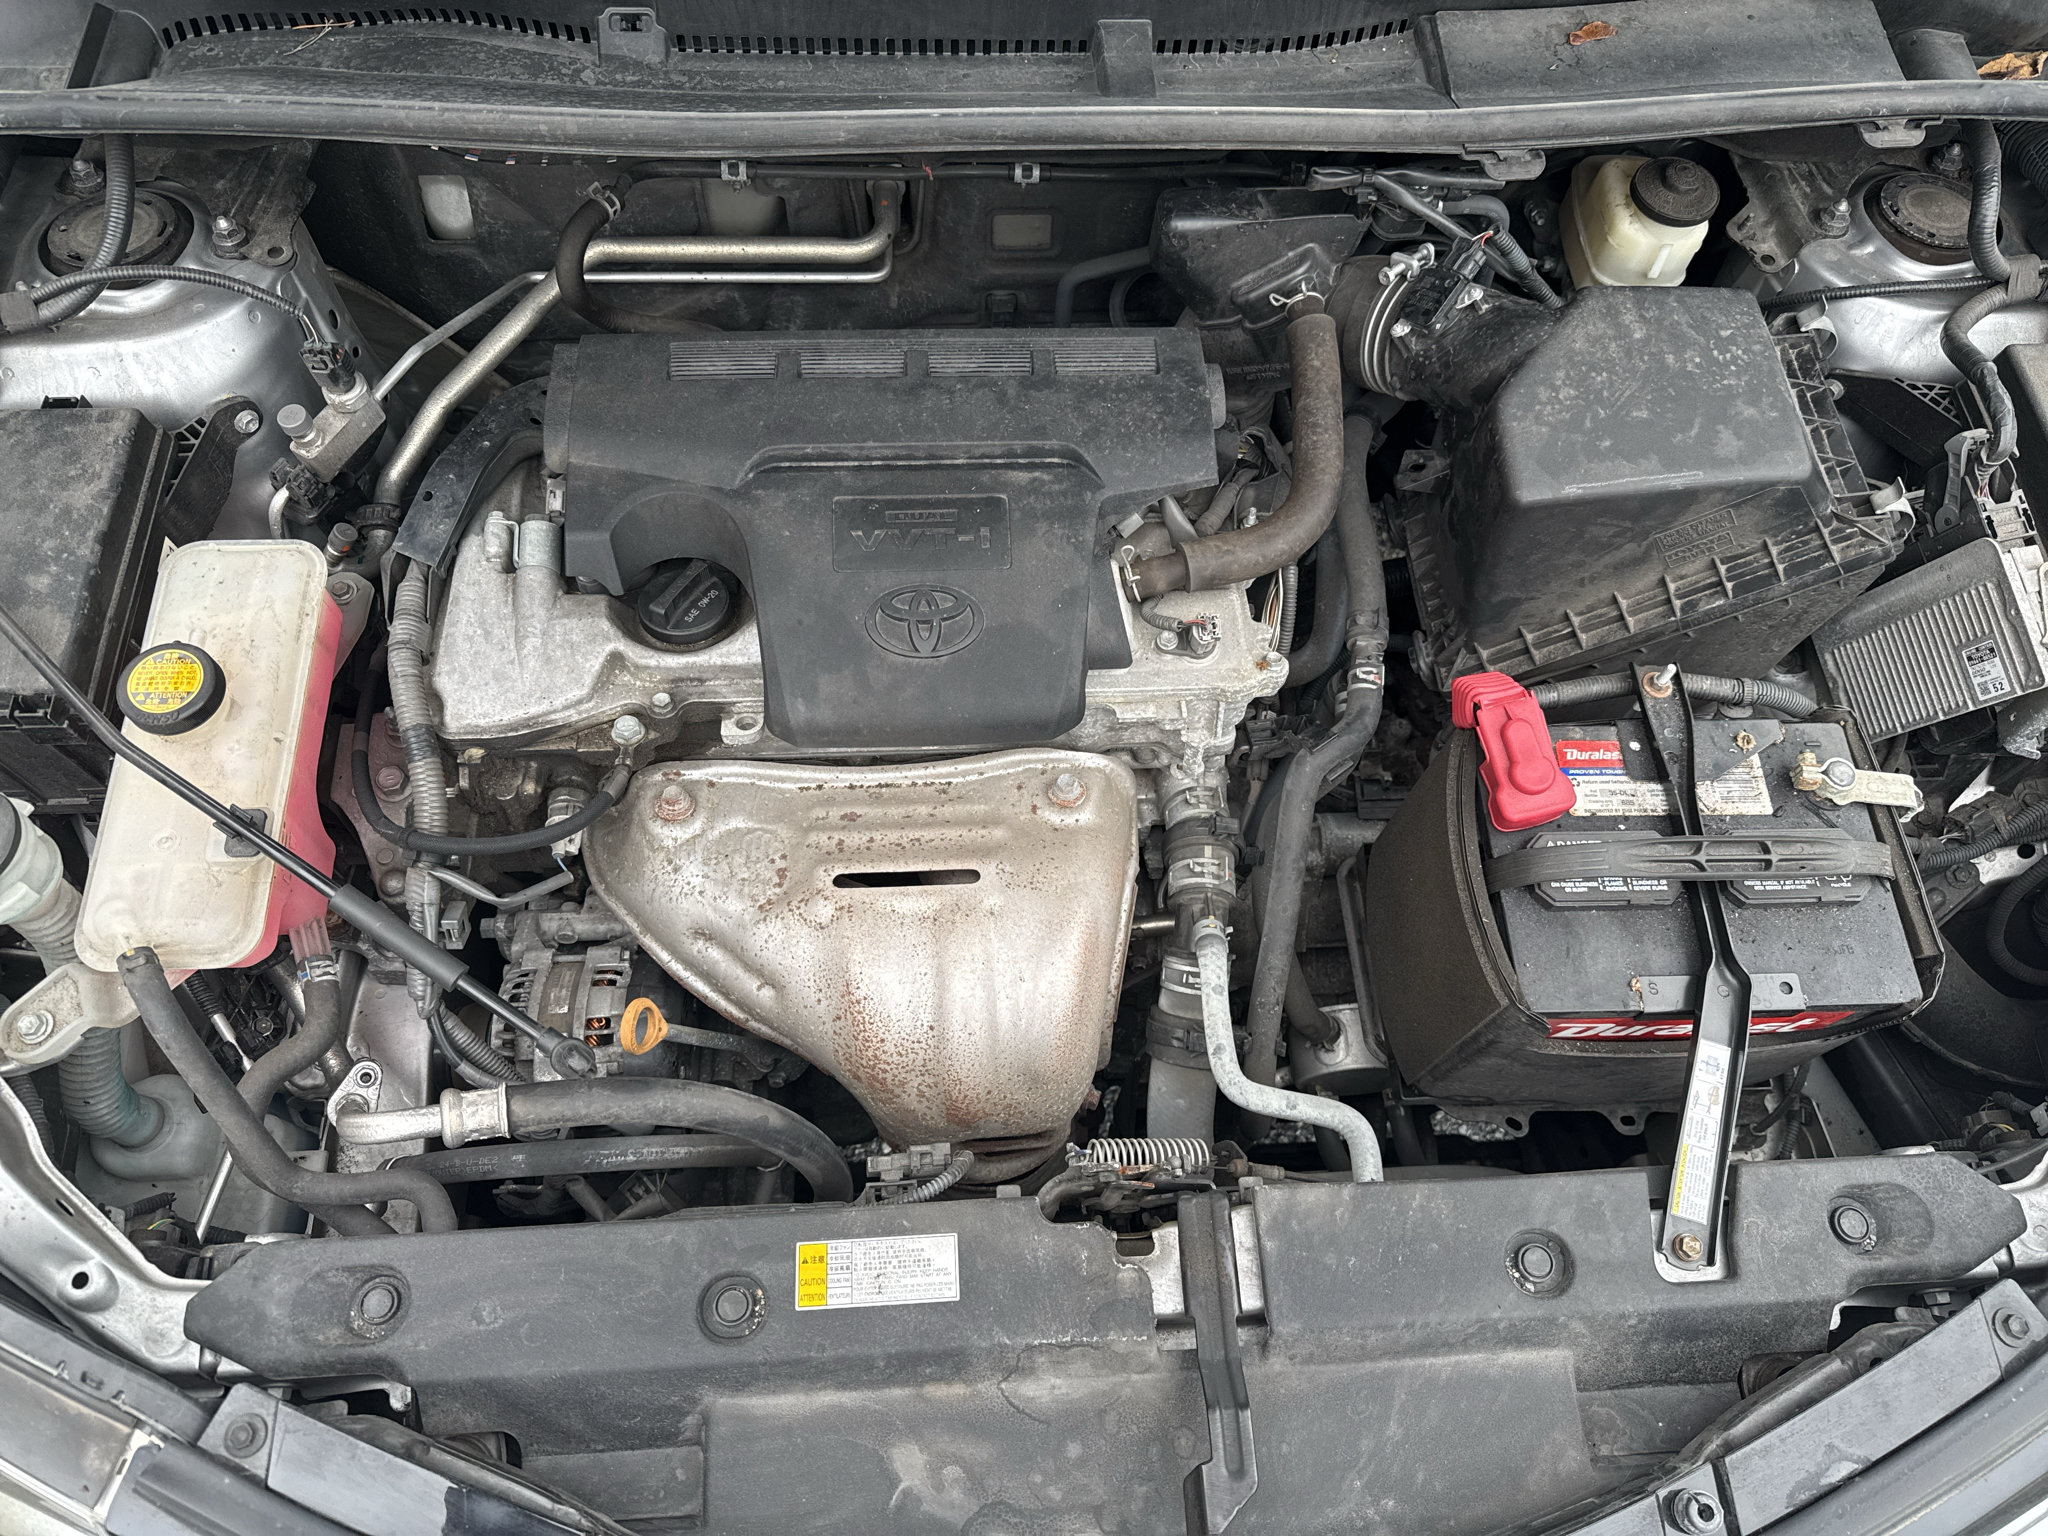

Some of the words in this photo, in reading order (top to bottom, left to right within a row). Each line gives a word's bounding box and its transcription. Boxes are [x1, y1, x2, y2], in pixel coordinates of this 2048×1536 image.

[684, 609, 700, 623] SAE
[697, 589, 719, 608] 0W-20
[1992, 681, 2005, 693] 52
[1562, 748, 1623, 760] Duralas
[1551, 1016, 1819, 1038] Durast
[800, 1277, 826, 1287] CAUTION
[800, 1293, 826, 1303] ATTENTION
